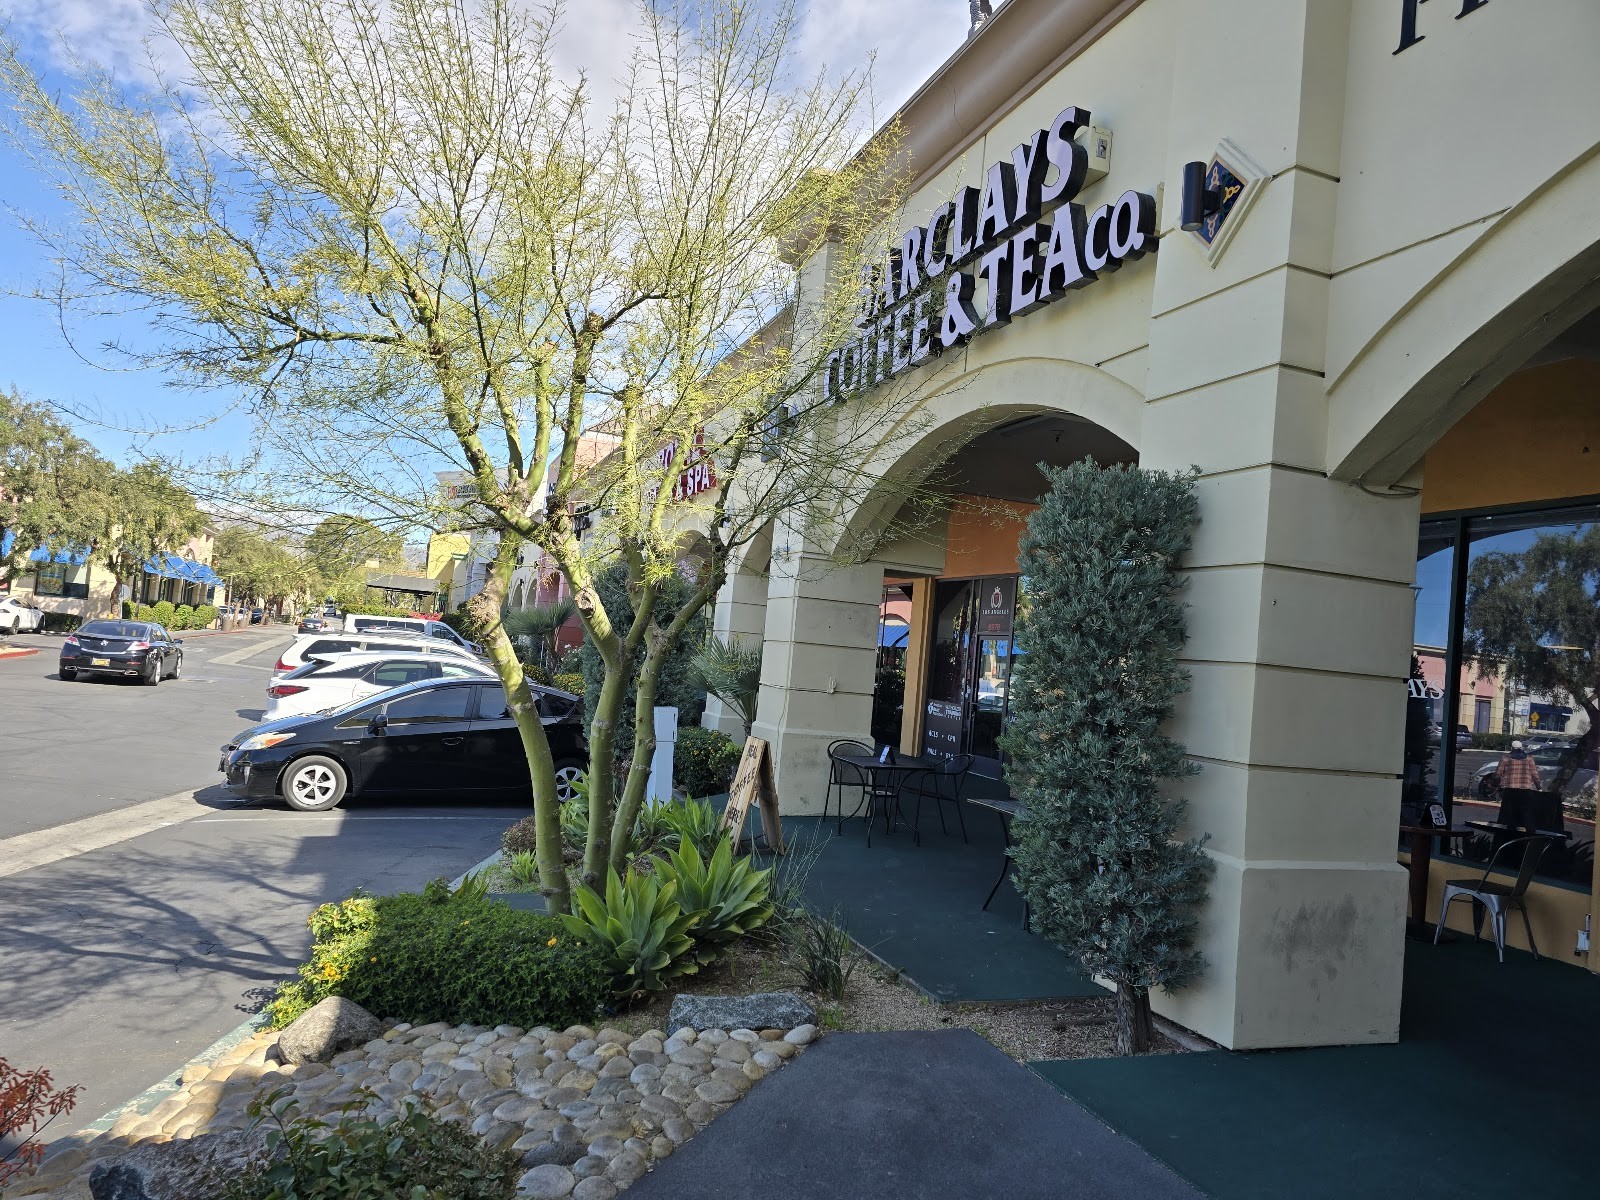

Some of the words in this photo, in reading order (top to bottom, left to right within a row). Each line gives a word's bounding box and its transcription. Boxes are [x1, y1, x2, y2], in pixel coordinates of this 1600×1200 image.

[941, 271, 977, 346] &
[980, 203, 1085, 325] TEA
[687, 464, 710, 497] SPA
